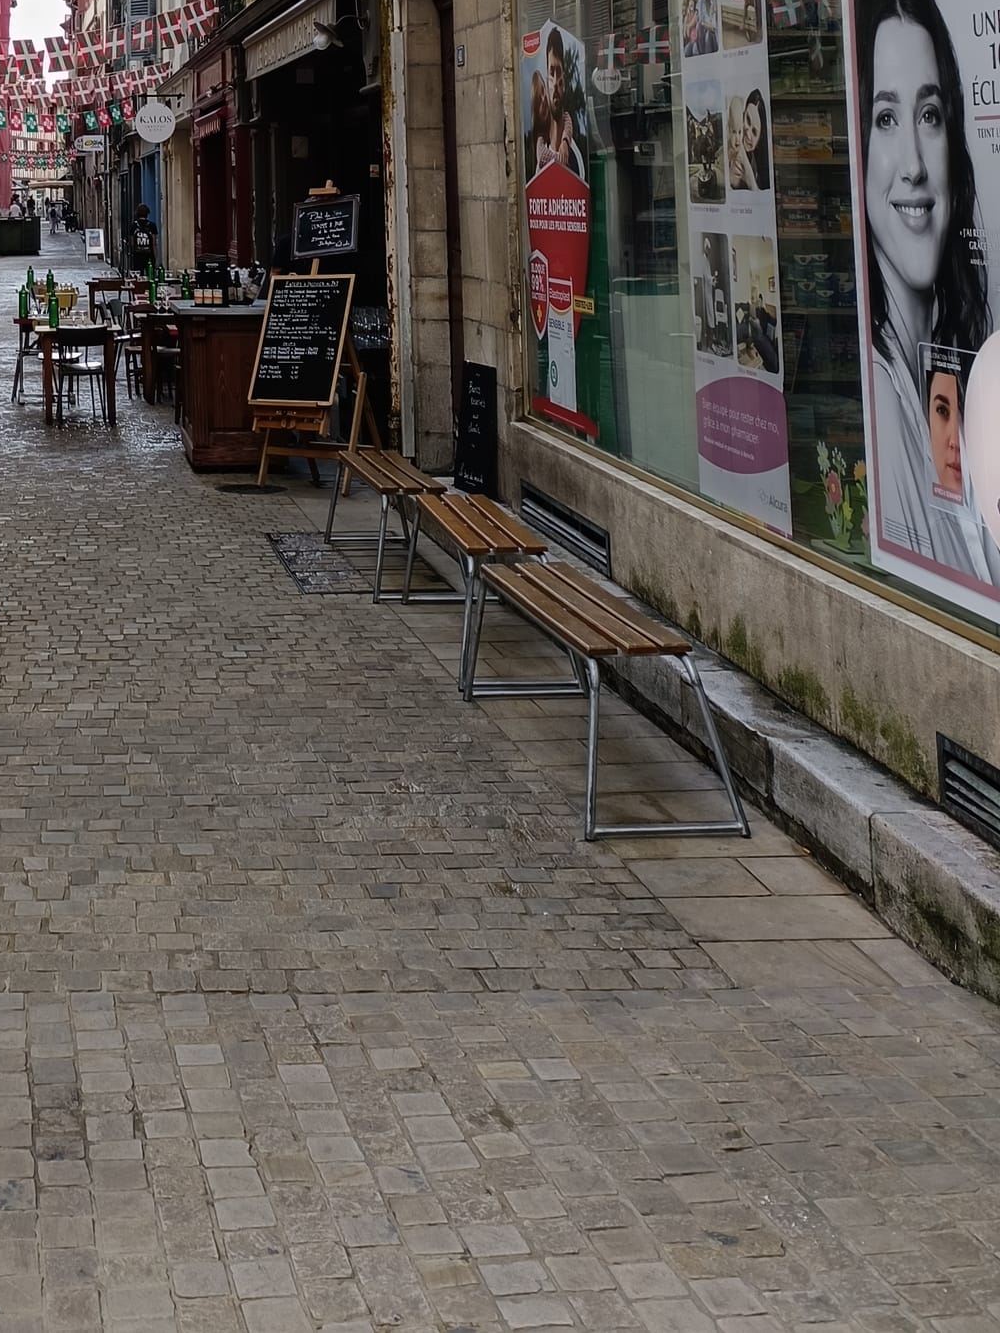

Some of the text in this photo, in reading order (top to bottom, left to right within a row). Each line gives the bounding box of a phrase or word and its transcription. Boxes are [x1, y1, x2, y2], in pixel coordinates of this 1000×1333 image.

[140, 115, 172, 123] KALOS
[529, 194, 586, 217] FORTE ADHÉRENCE
[531, 275, 545, 294] 99%
[768, 494, 788, 513] Alcura
